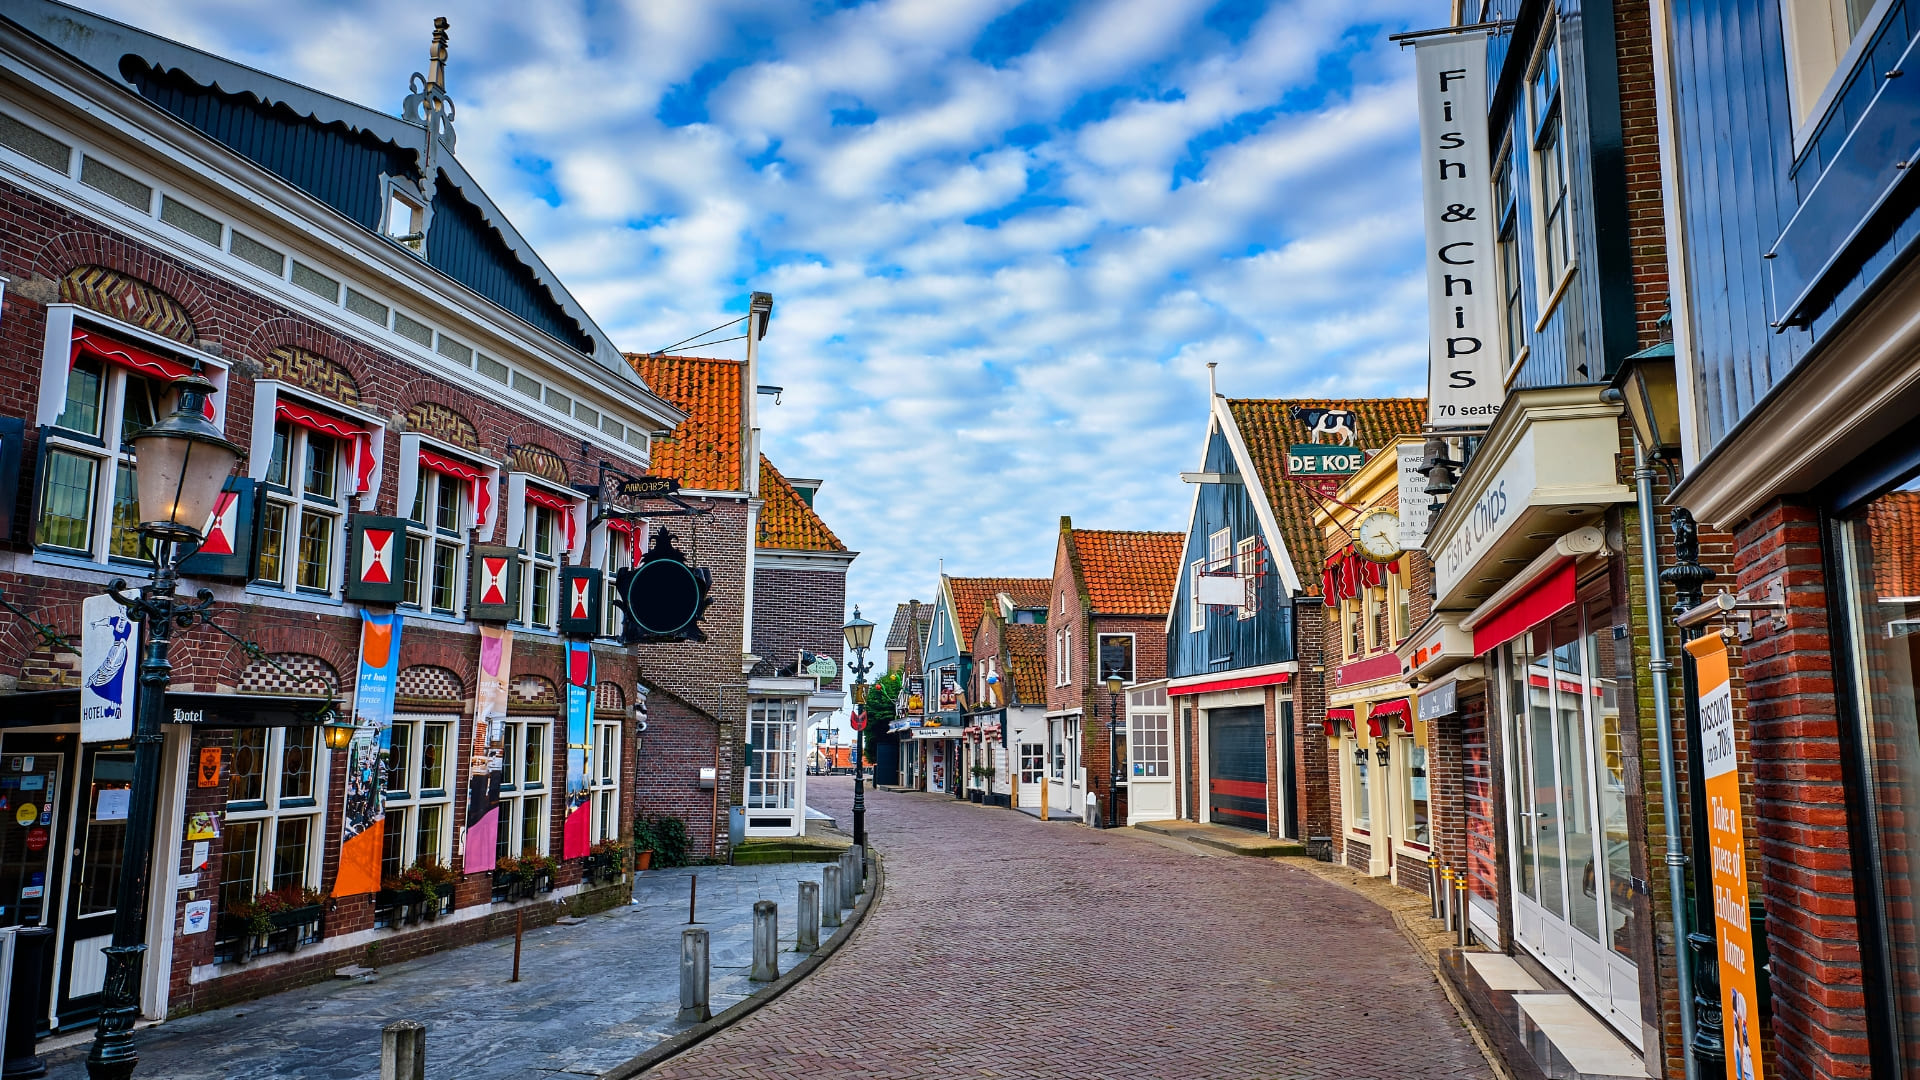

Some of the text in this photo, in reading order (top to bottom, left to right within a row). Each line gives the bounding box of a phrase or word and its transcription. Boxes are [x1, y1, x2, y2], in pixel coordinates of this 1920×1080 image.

[1438, 68, 1482, 389] Fish & Chips
[1438, 402, 1500, 417] 70 seats
[1290, 454, 1363, 472] DE KOE
[1447, 479, 1507, 578] Fish & Chips
[83, 705, 104, 721] HOTEL
[173, 708, 203, 723] Hotel
[1701, 692, 1730, 733] DISCOUNT
[1707, 726, 1732, 766] up to 70%
[1711, 796, 1736, 834] Take a
[1713, 836, 1742, 887] piece of
[1715, 884, 1747, 933] Holland
[1723, 927, 1746, 975] home
